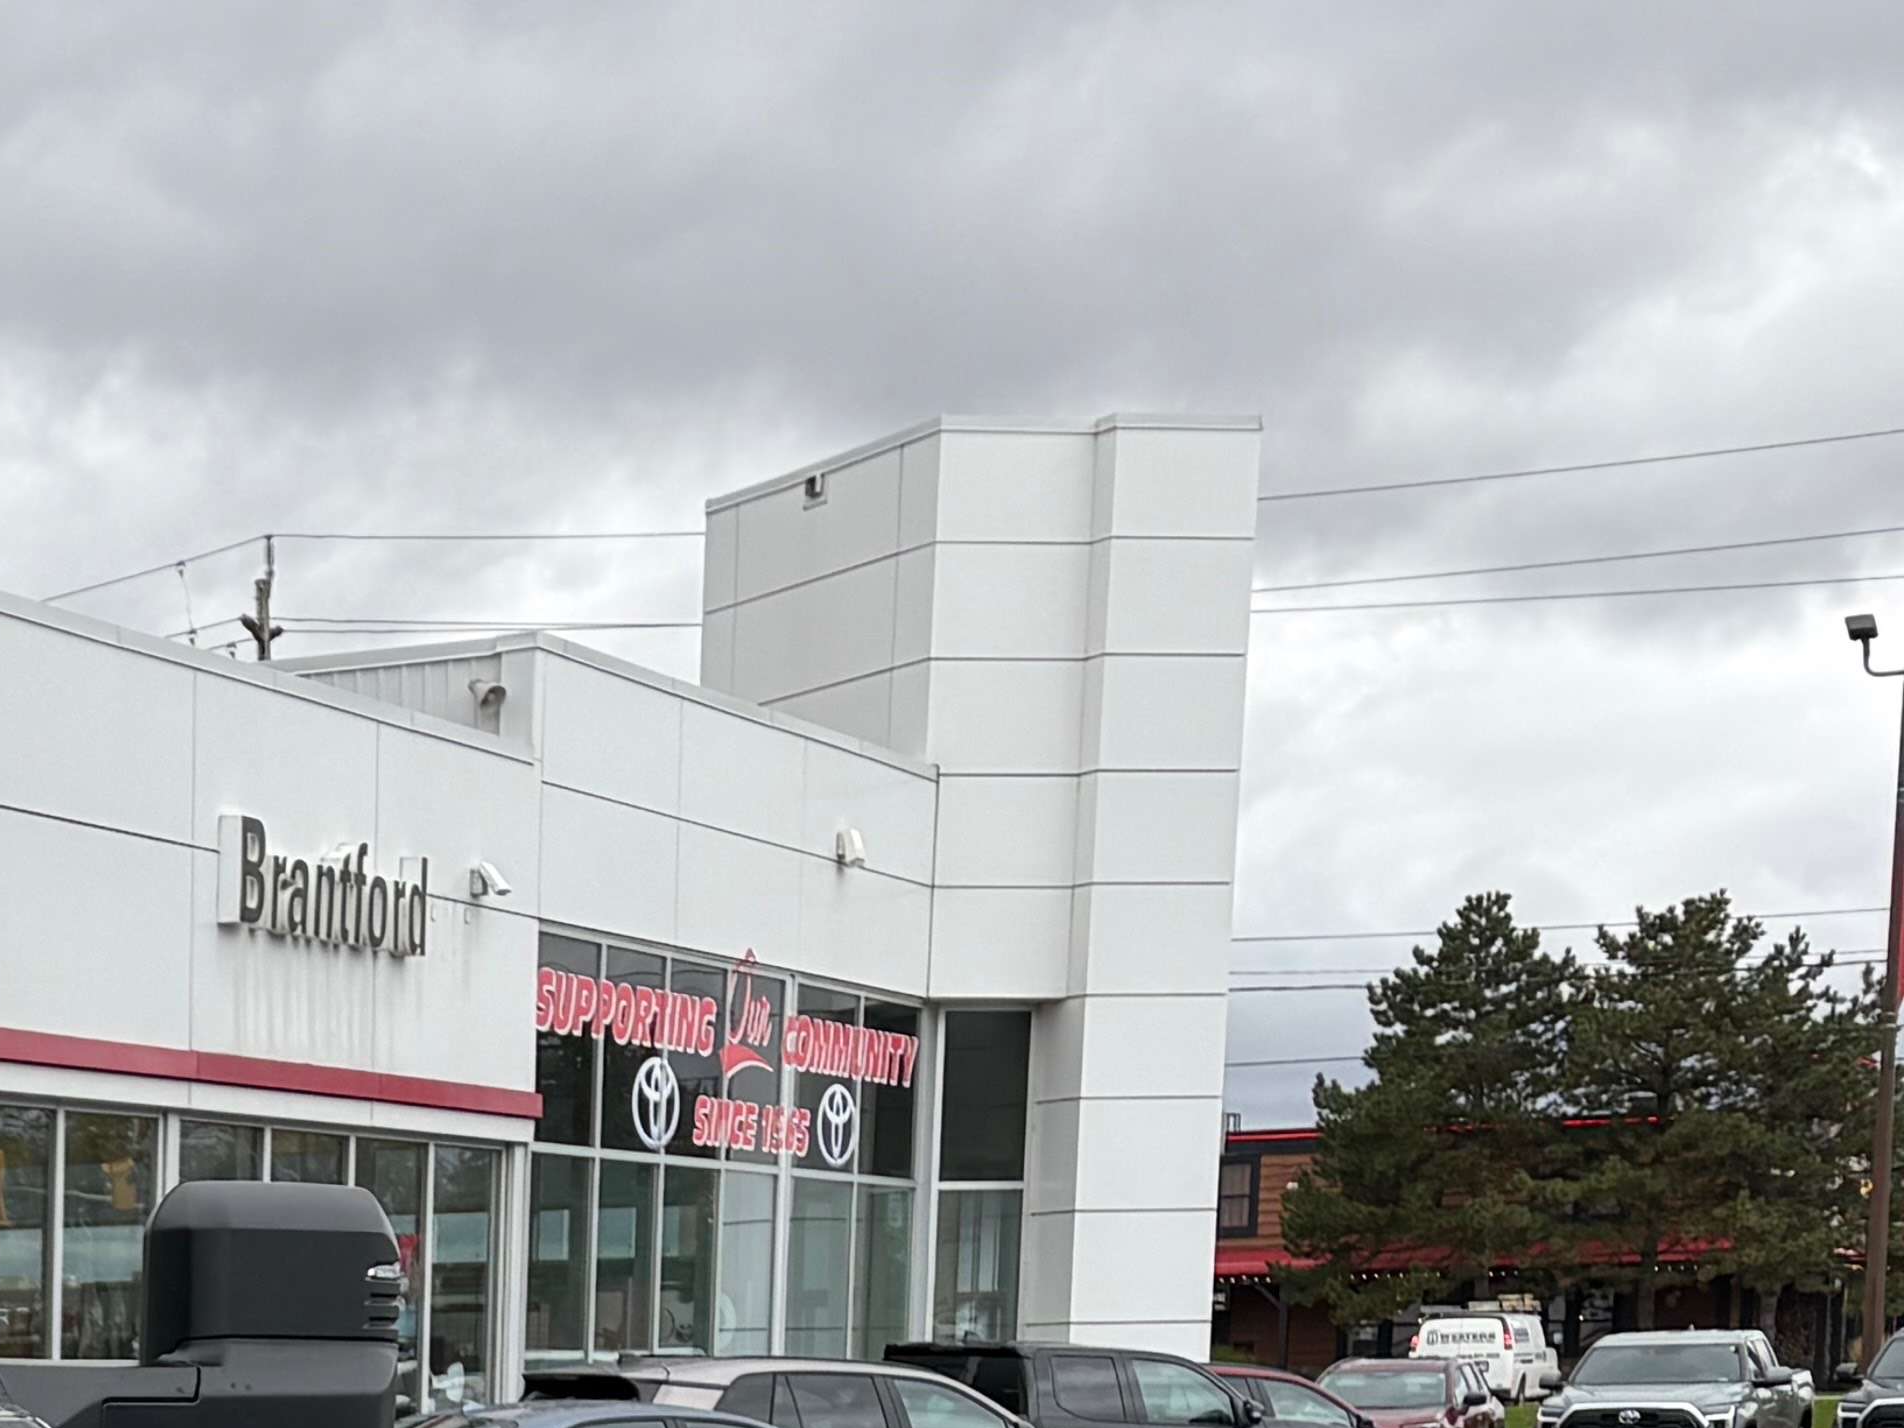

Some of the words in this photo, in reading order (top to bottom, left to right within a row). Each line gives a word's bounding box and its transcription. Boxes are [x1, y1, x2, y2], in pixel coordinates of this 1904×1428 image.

[238, 815, 428, 957] Brantford
[535, 966, 718, 1057] SUPPORTING
[782, 1014, 920, 1088] COMMUNITY
[693, 1094, 760, 1152] SINCE
[762, 1104, 812, 1158] 1965
